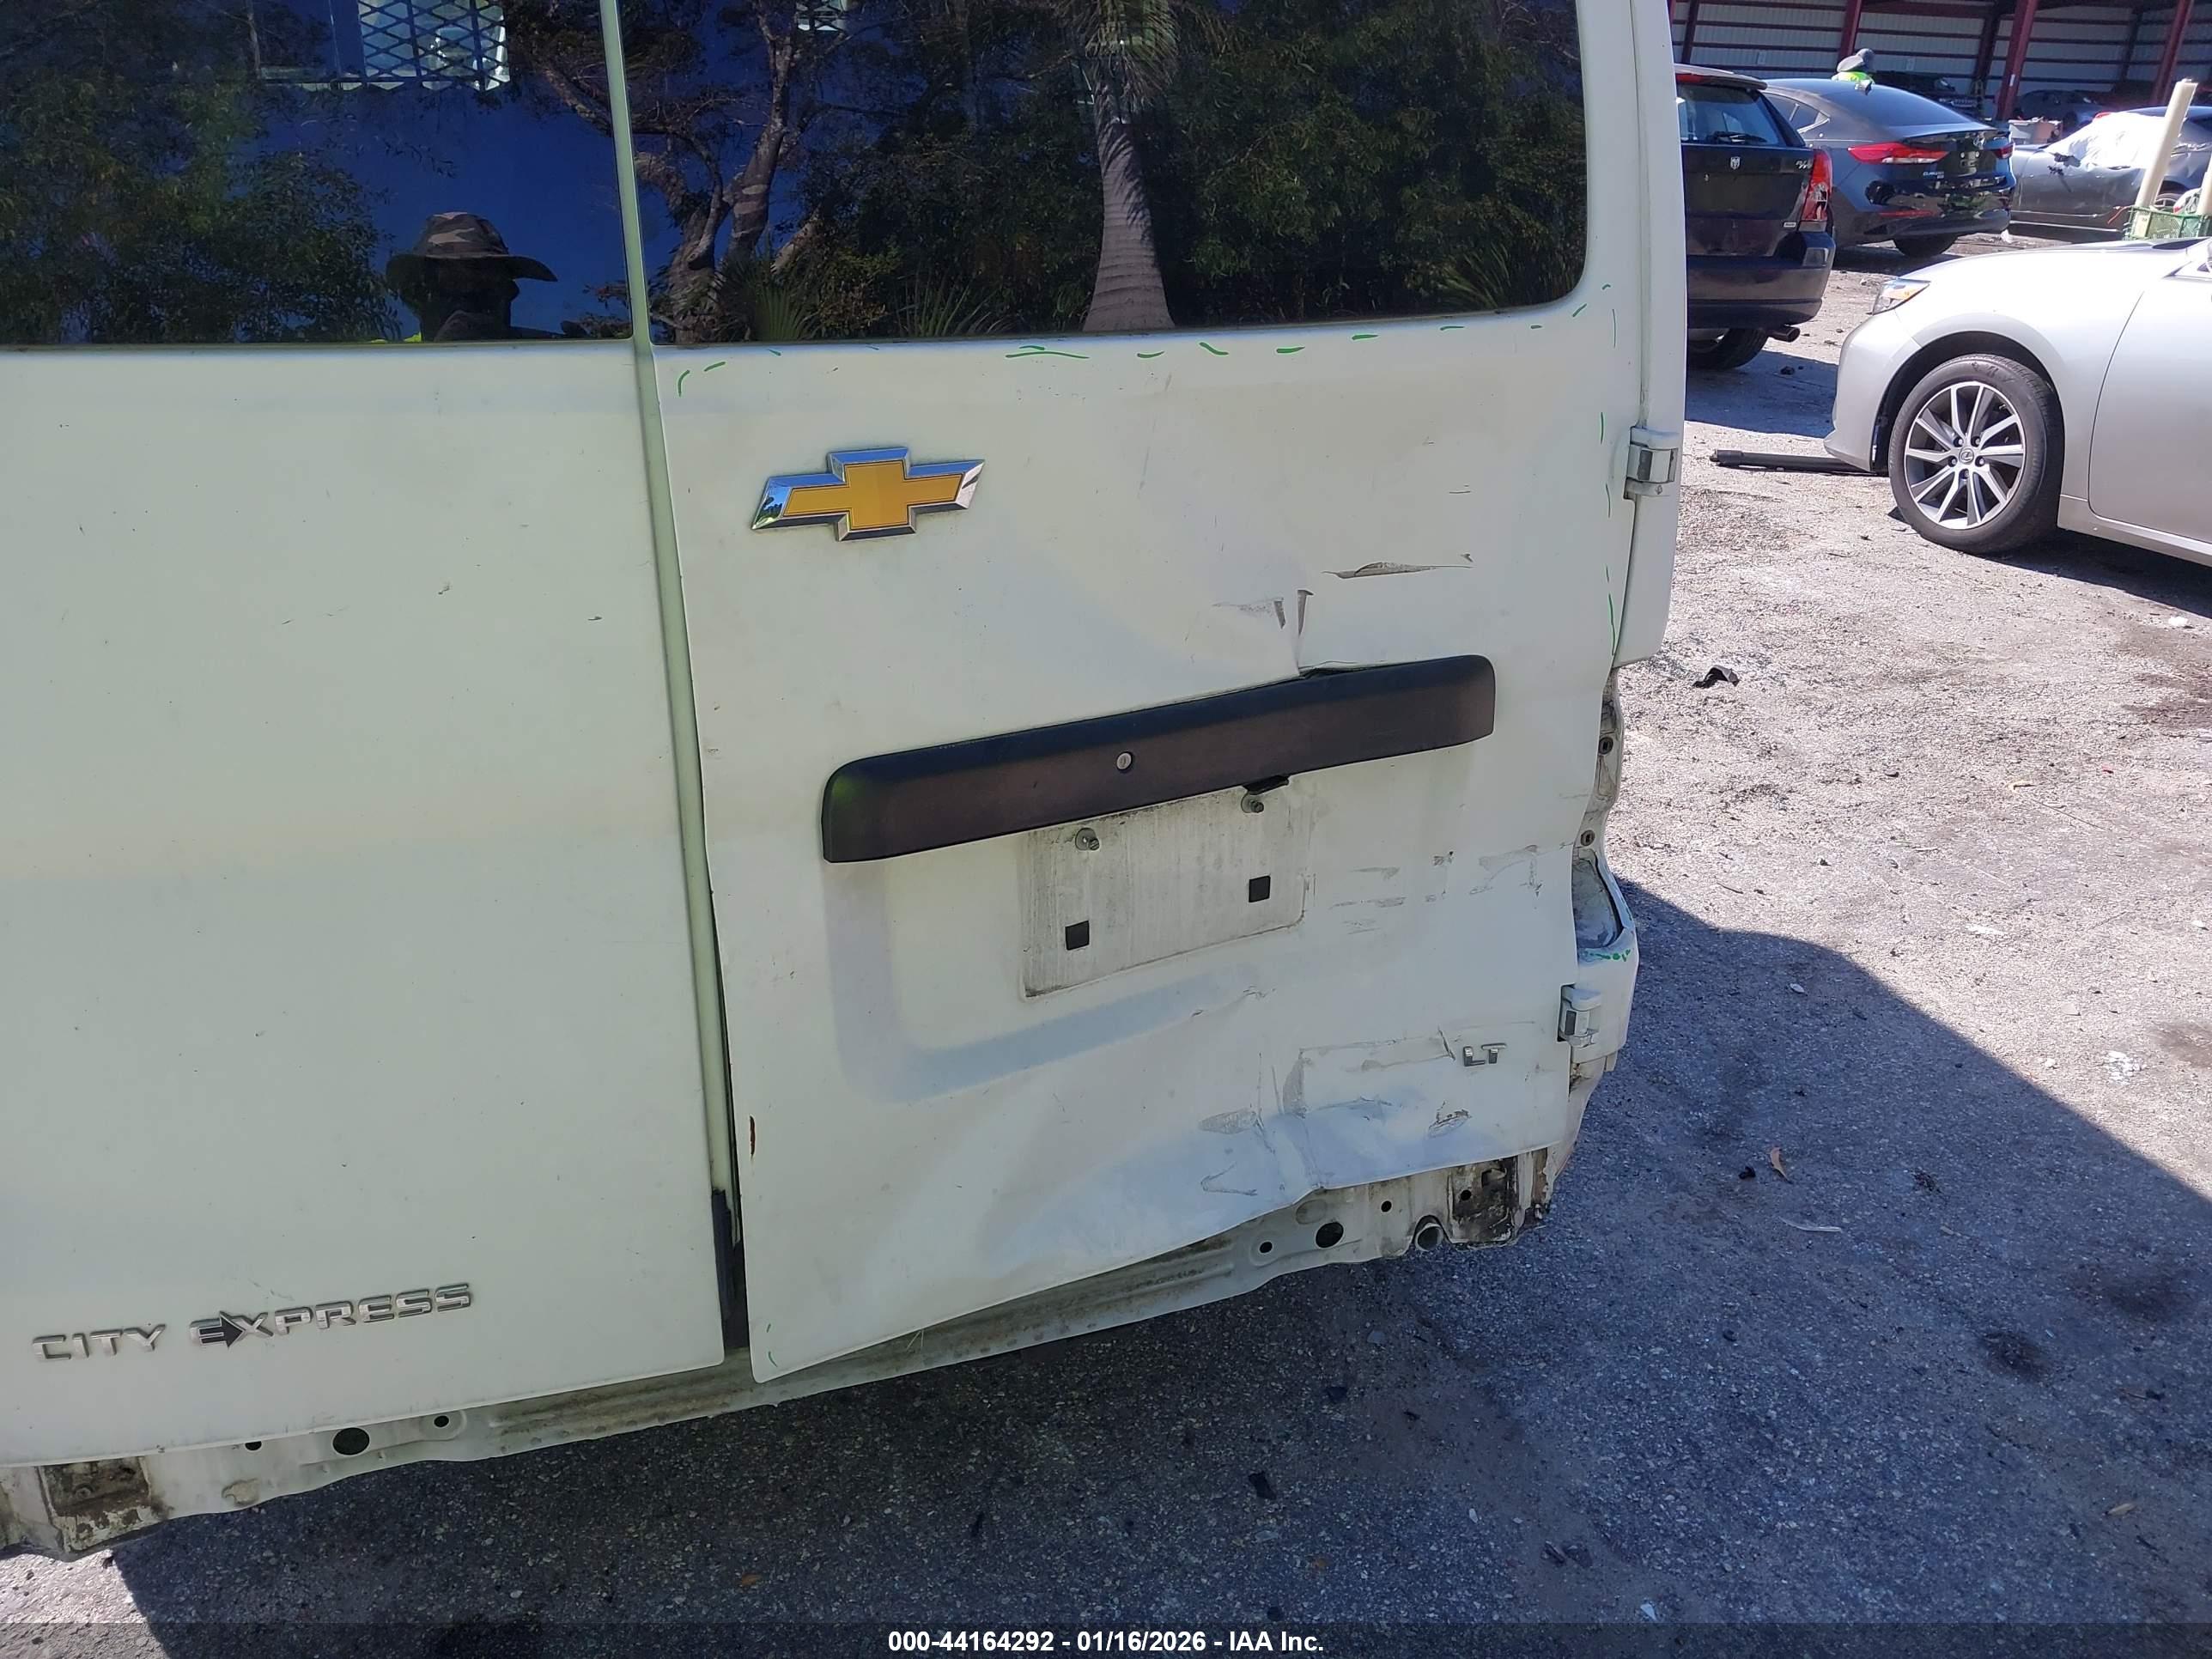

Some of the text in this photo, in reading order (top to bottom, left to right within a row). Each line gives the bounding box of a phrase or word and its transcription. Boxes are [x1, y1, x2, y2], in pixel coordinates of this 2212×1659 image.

[1462, 1042, 1507, 1066] LT
[32, 1282, 473, 1361] CITY EXPRESS
